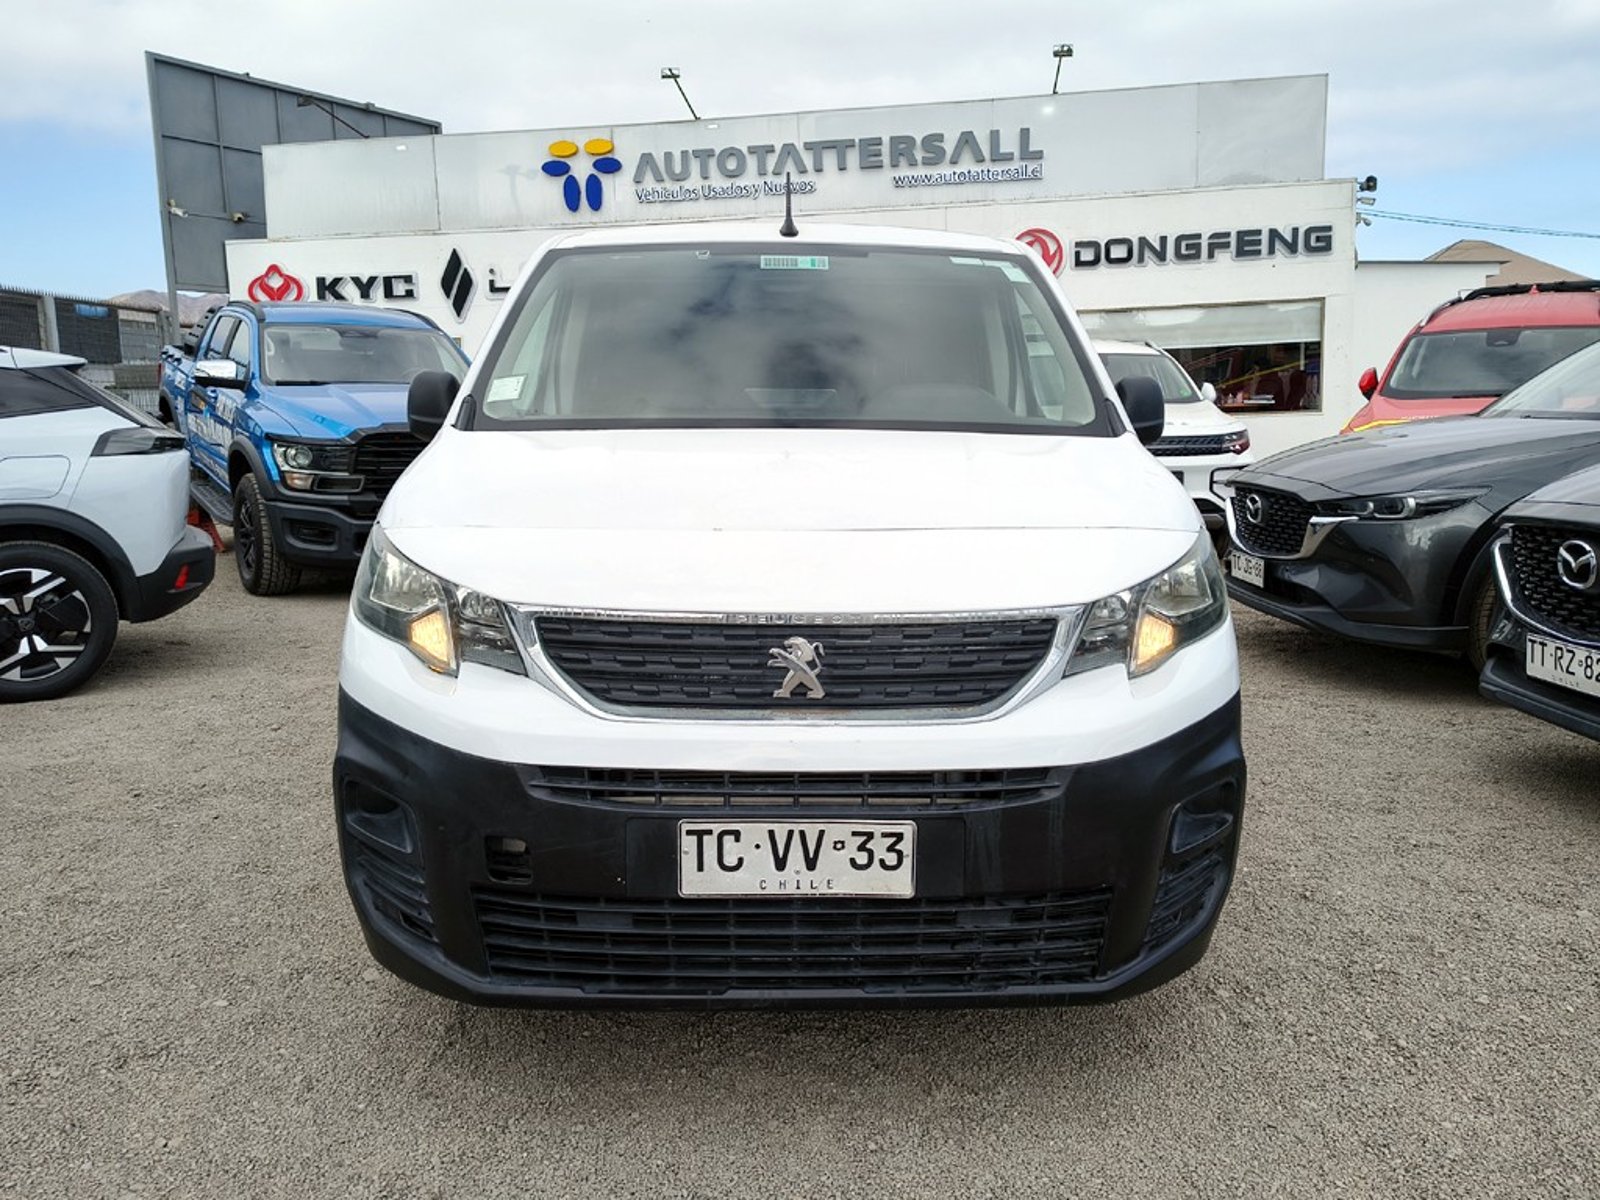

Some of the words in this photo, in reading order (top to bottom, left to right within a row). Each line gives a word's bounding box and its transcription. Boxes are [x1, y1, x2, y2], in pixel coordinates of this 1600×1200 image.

[633, 128, 1044, 183] AUTOTATTERSALL
[893, 163, 1043, 187] www.autotattersall.cl
[701, 182, 750, 199] Usados
[750, 184, 760, 200] y
[1074, 225, 1333, 268] DONGFENG
[316, 274, 415, 301] KYC
[758, 879, 834, 891] CHILE
